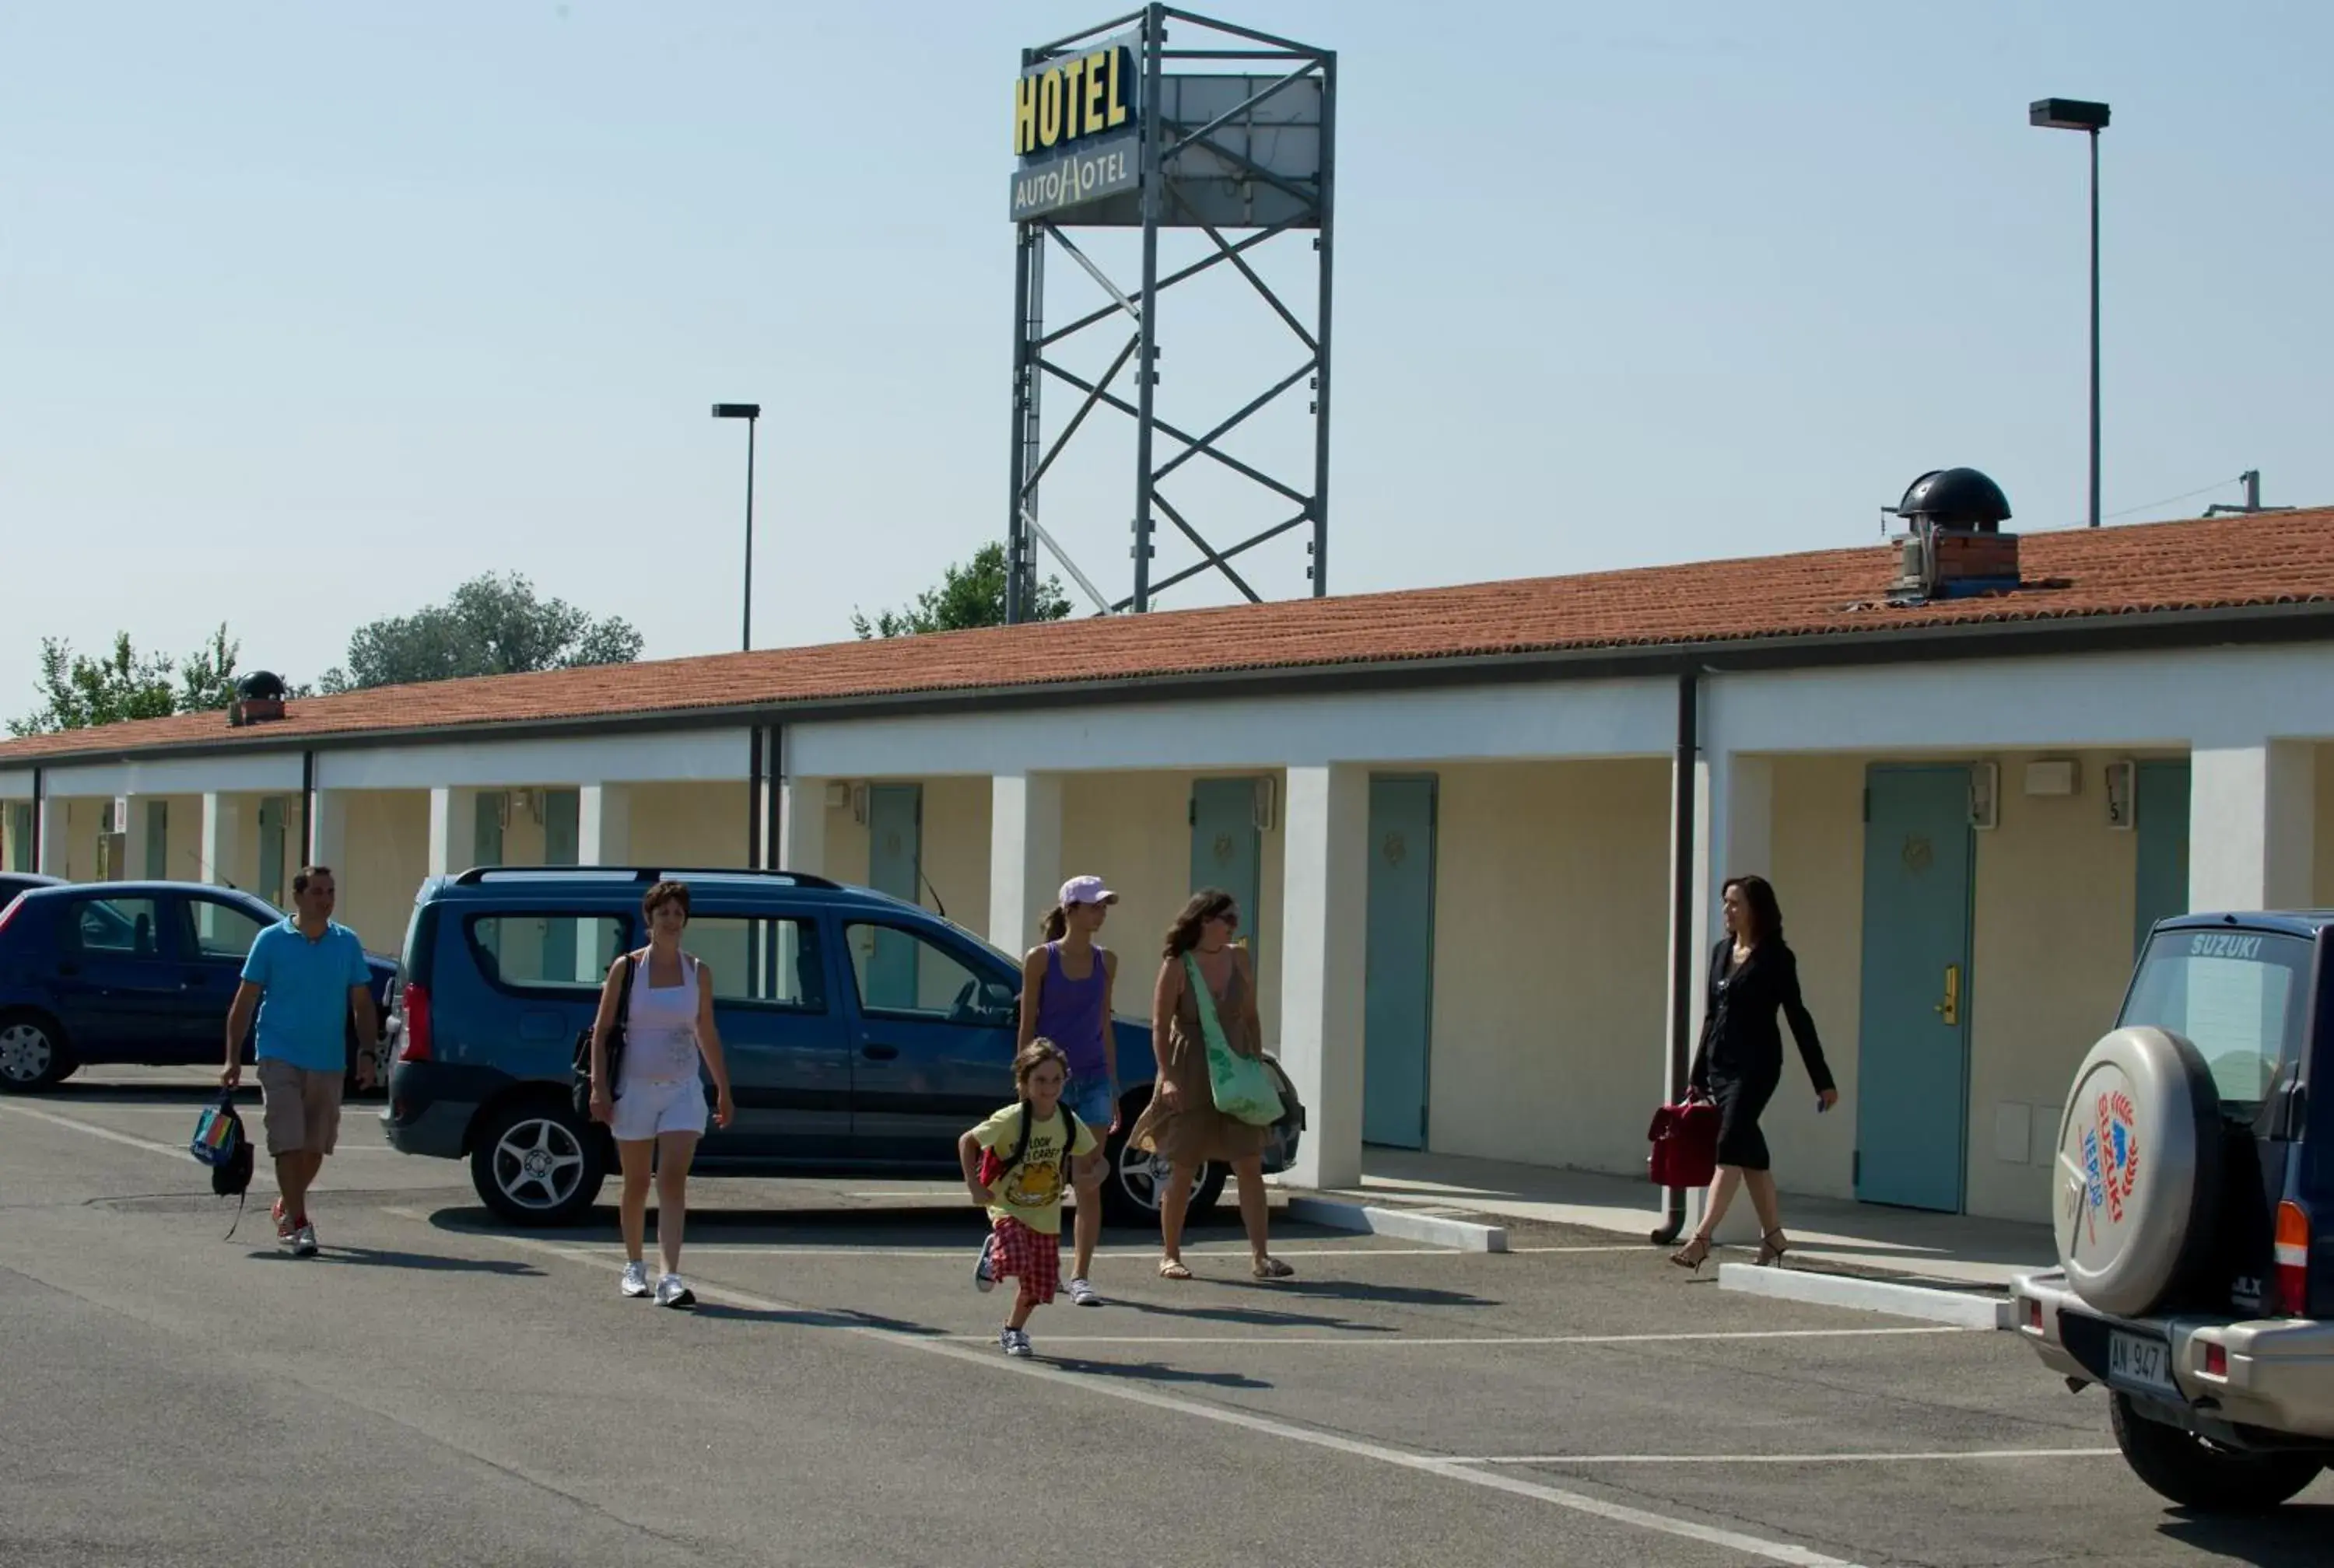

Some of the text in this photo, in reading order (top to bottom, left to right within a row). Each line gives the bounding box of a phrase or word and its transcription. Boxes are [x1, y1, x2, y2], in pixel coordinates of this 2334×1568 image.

[1015, 47, 1126, 156] HOTEL
[2191, 933, 2262, 959] SUZUKI
[2098, 1093, 2122, 1223] SUZUKI
[2109, 1337, 2128, 1374] AN
[2133, 1342, 2159, 1381] 947
